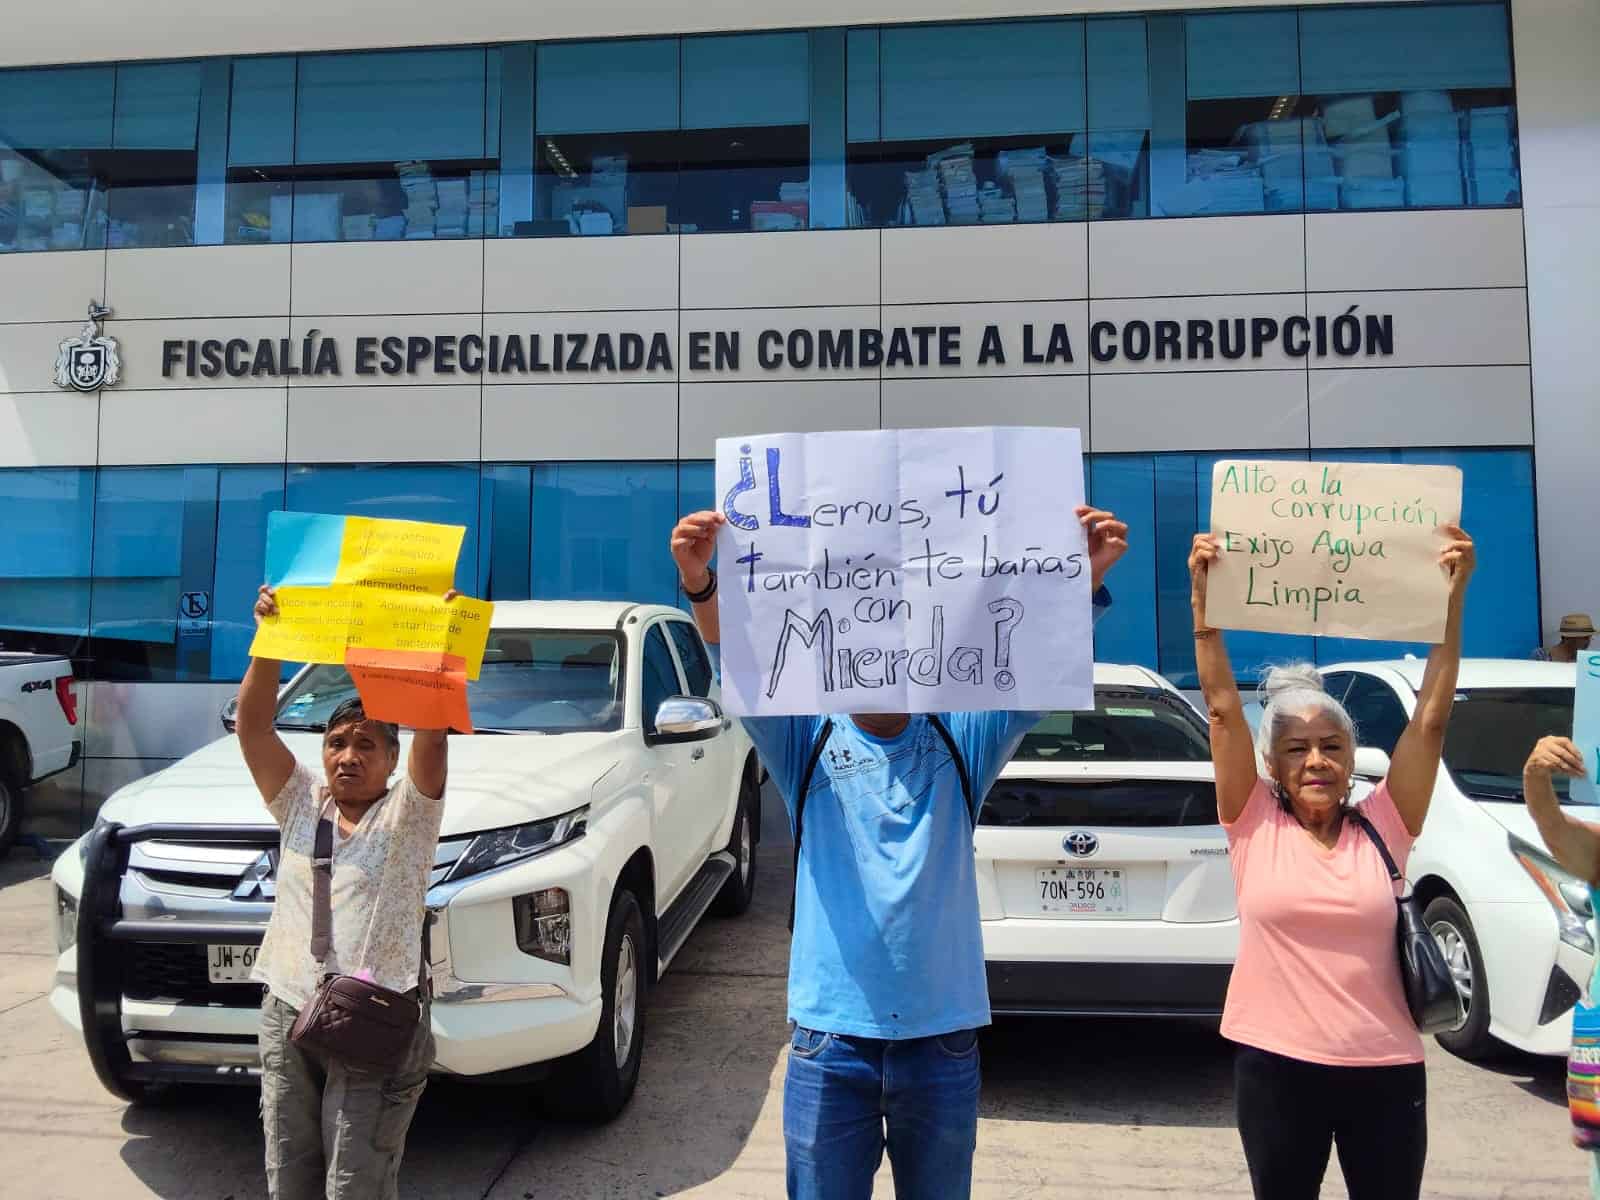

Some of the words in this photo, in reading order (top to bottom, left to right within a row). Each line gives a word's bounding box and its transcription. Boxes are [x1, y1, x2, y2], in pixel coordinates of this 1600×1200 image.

[161, 328, 341, 378] FISCALÍA
[355, 331, 674, 375] ESPECIALIZADA
[688, 331, 740, 371] EN
[757, 326, 961, 370] COMBATE
[977, 325, 1006, 365] A
[1022, 323, 1074, 364] LA
[1090, 304, 1394, 363] CORRUPCIÓN
[723, 444, 931, 530] ¿Lemus,
[945, 465, 1003, 519] tú
[1220, 465, 1277, 494] Alto
[1291, 478, 1308, 495] a
[1320, 466, 1343, 497] la
[1272, 497, 1438, 535] corrupción
[735, 541, 897, 593] también
[908, 538, 964, 588] te
[981, 534, 1083, 580] bañas
[1225, 531, 1295, 568] Exijo
[1312, 529, 1387, 573] Agua
[853, 596, 912, 623] con
[1246, 566, 1365, 622] Limpia
[765, 597, 1025, 699] Mierda?
